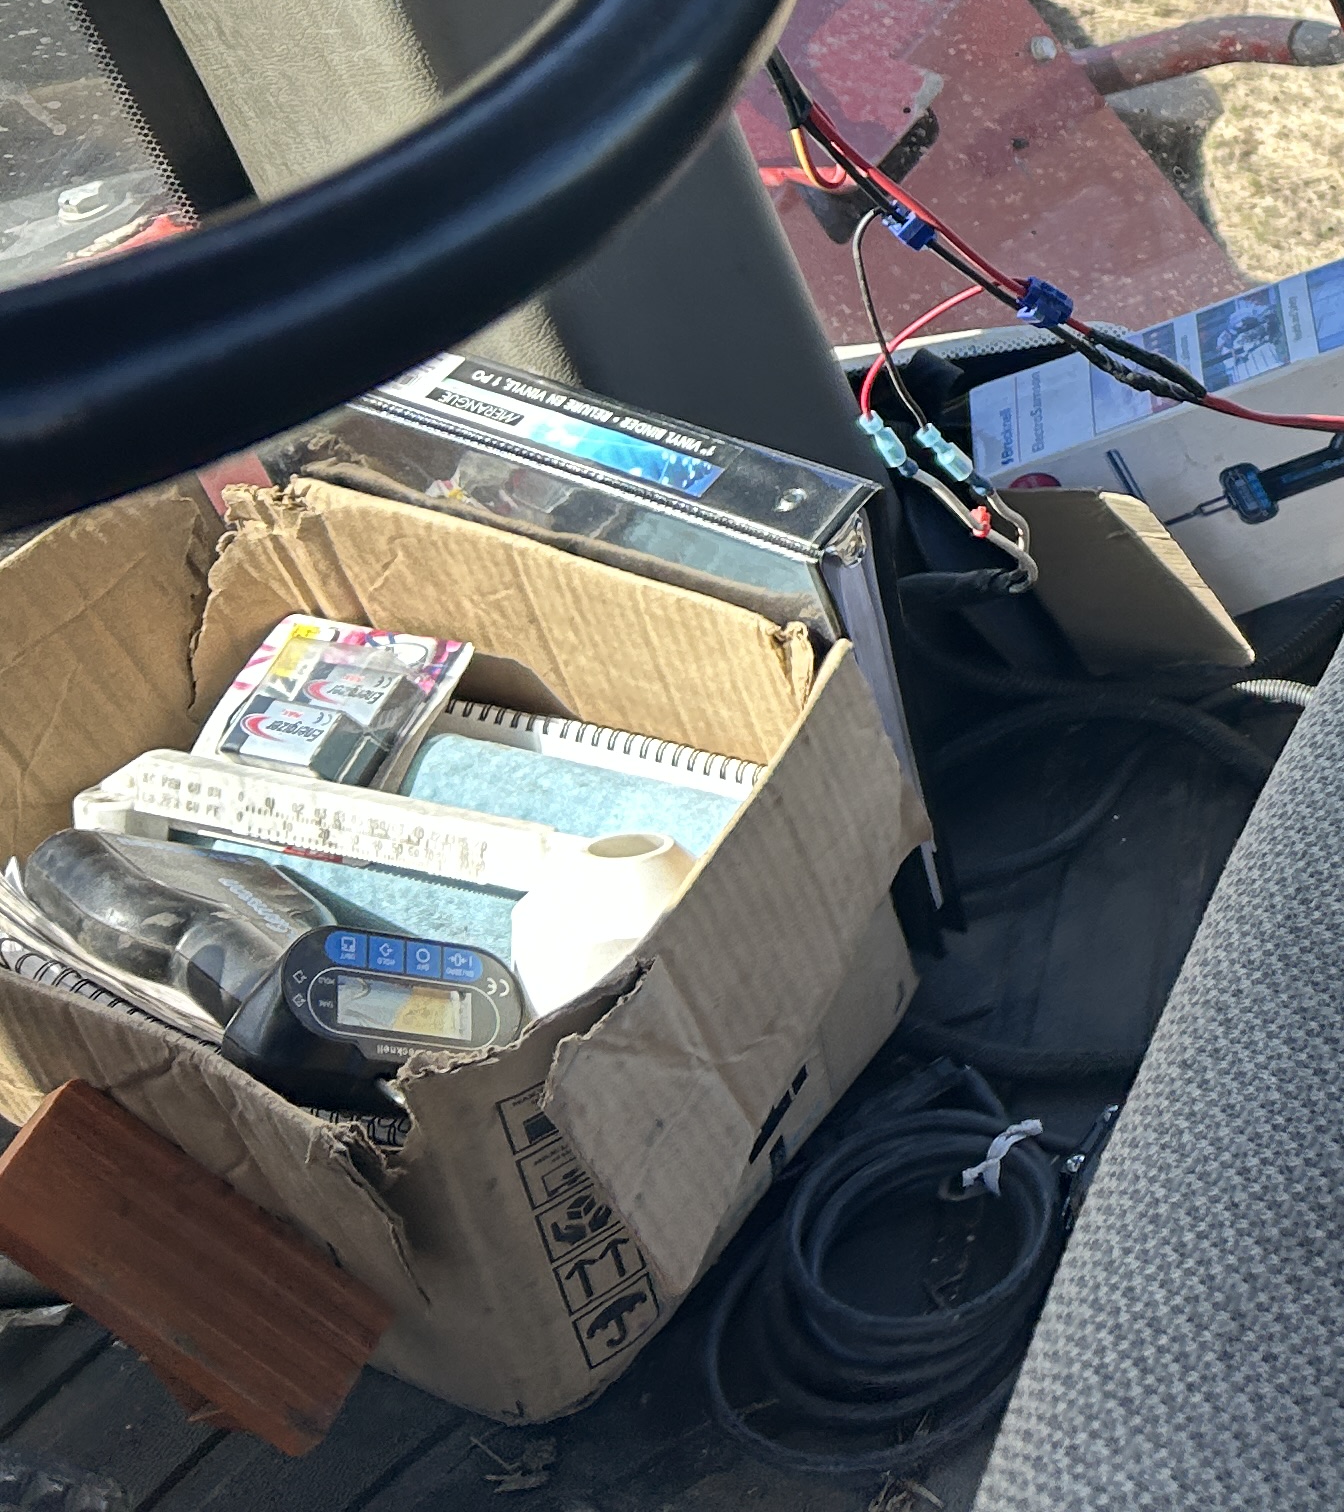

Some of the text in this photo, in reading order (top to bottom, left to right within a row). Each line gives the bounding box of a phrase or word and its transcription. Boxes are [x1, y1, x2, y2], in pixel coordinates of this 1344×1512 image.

[472, 369, 493, 385] PO
[438, 391, 522, 425] MERANGUE
[549, 394, 567, 407] EN
[563, 398, 614, 423] RELIURE
[620, 416, 667, 440] BINDER
[665, 429, 702, 453] VINYL
[327, 684, 384, 704] Energizer
[266, 719, 325, 742] Energizer
[487, 977, 510, 997] CE
